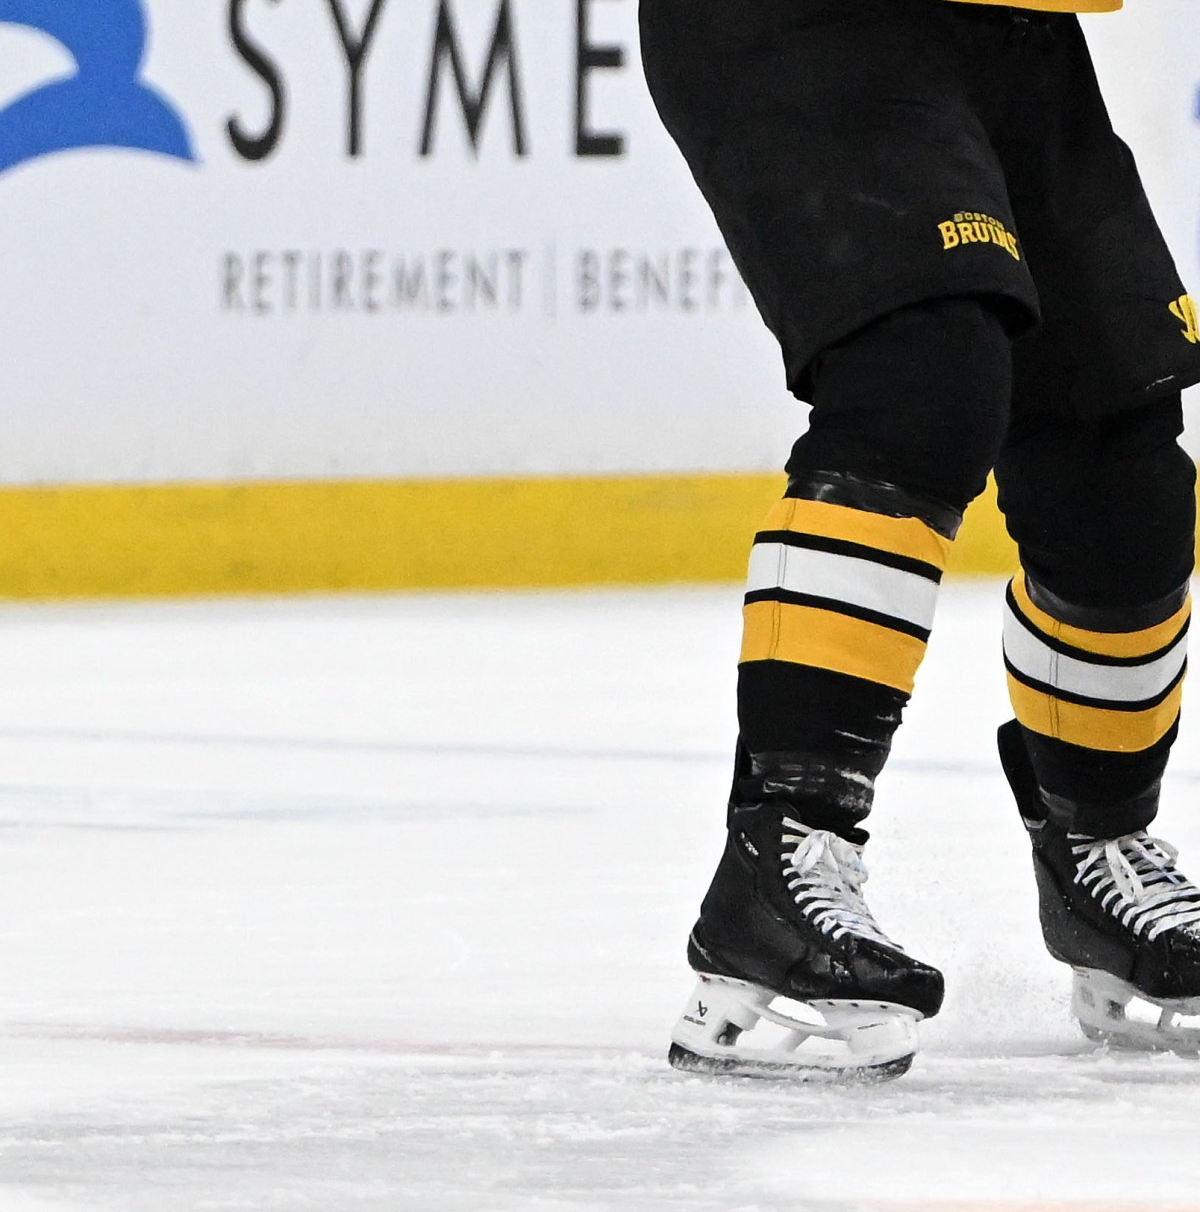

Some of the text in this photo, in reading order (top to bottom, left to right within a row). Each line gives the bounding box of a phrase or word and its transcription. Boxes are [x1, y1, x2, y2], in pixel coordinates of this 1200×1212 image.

[937, 220, 1020, 261] BRUINS
[953, 211, 1005, 231] BOSTON
[219, 248, 527, 314] RETIREMENT
